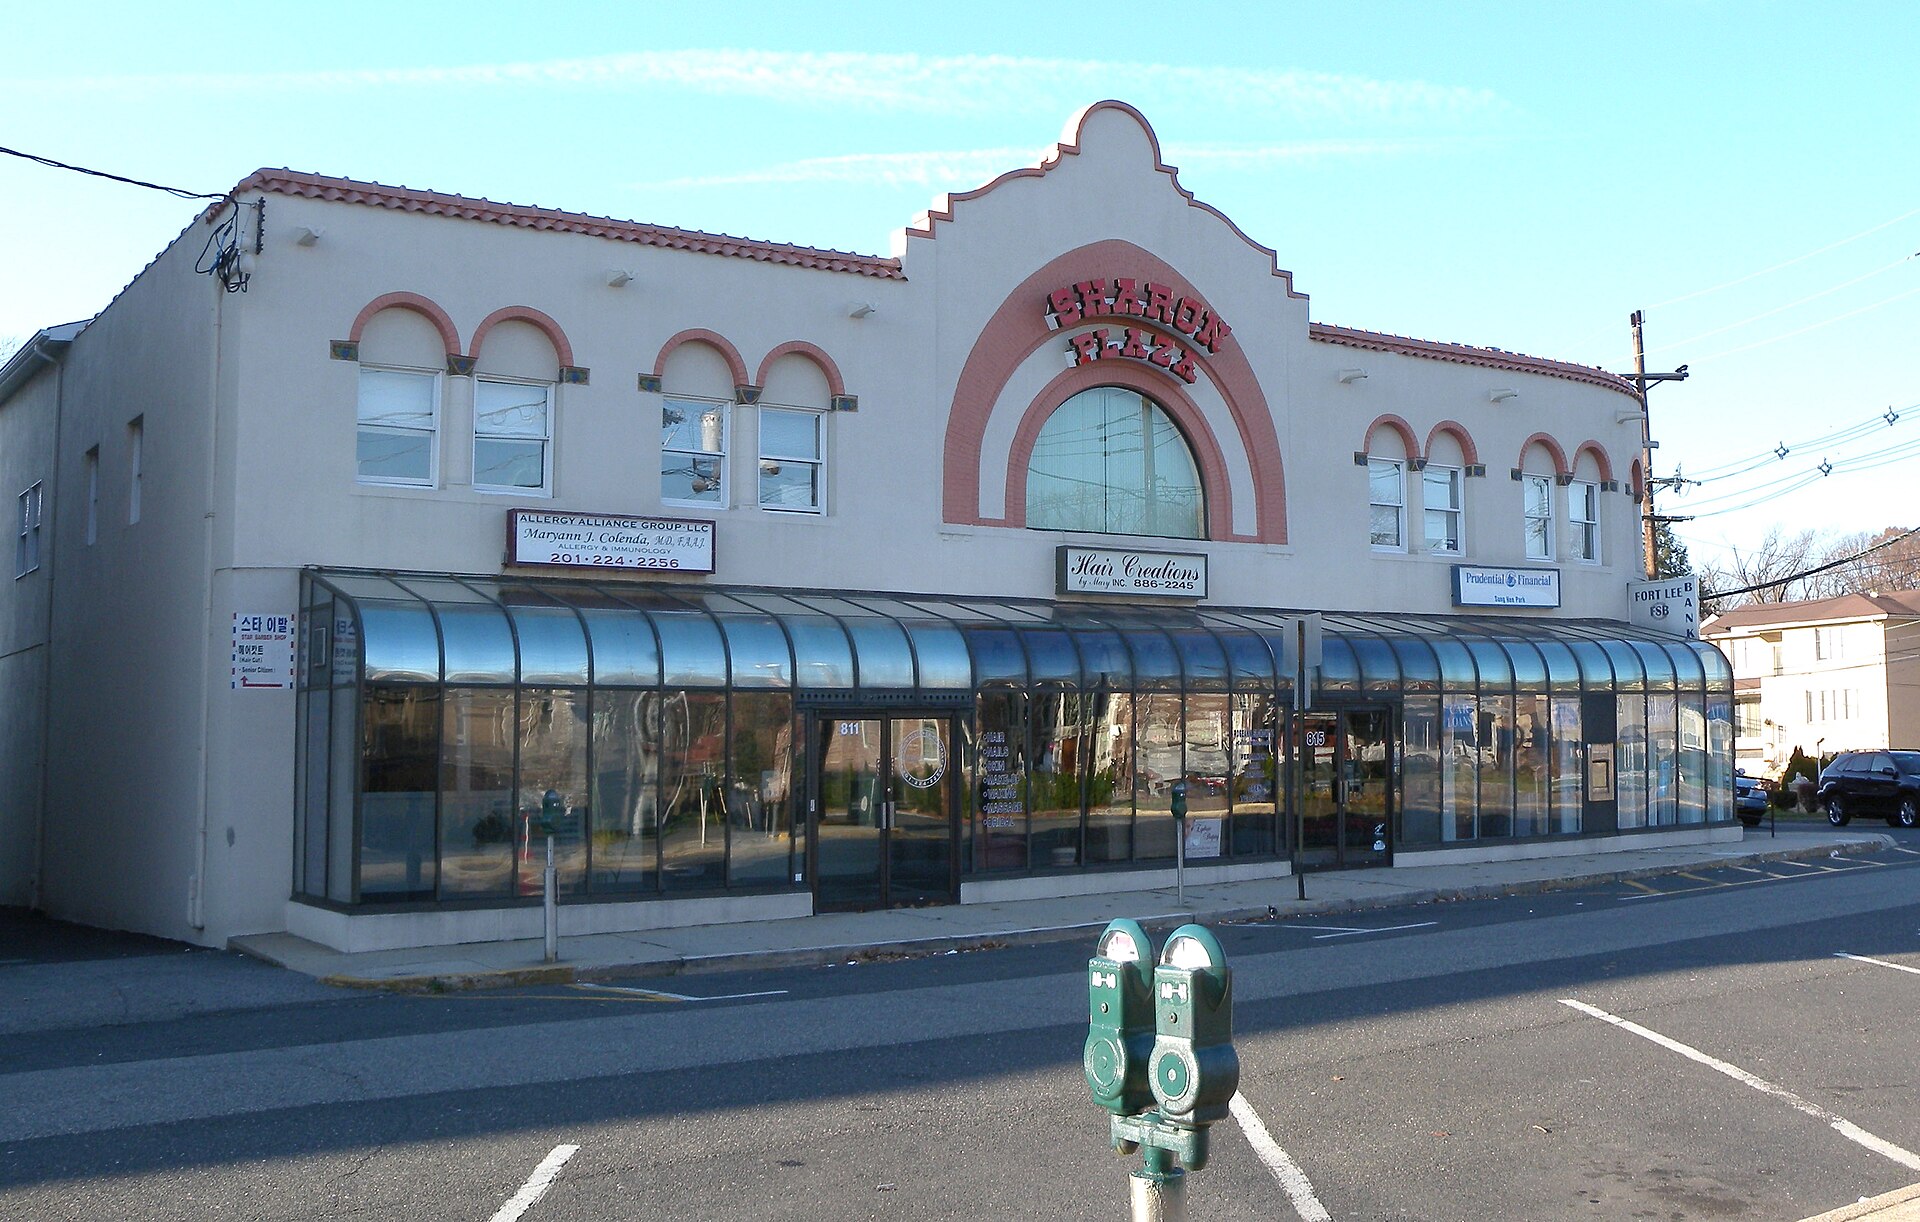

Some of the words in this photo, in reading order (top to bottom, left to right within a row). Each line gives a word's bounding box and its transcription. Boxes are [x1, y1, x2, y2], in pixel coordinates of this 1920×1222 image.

[1047, 278, 1232, 353] SHARON
[1067, 328, 1197, 384] PLAZA
[519, 514, 576, 525] ALLERGY
[579, 518, 637, 529] ALLIANCE
[523, 528, 582, 543] Maryann
[583, 531, 595, 543] J.
[599, 532, 651, 546] Colenda,
[558, 543, 599, 551] ALLERGY
[611, 545, 672, 555] IMMUNOLOGY
[1071, 553, 1114, 577] Hair
[1121, 554, 1199, 582] Creations
[1078, 576, 1088, 589] by
[1112, 578, 1127, 588] INC.
[1133, 579, 1194, 590] 886-2245
[1466, 572, 1505, 585] Prudential
[1517, 574, 1551, 586] Financial
[1634, 589, 1661, 602] FORT
[1664, 587, 1683, 599] LEE
[1650, 605, 1669, 617] FSB
[1684, 582, 1695, 639] BANK
[241, 616, 262, 633] 스타
[267, 616, 288, 633] 이발
[840, 722, 860, 736] 811
[986, 731, 1005, 743] HAIR
[1306, 731, 1326, 746] 815
